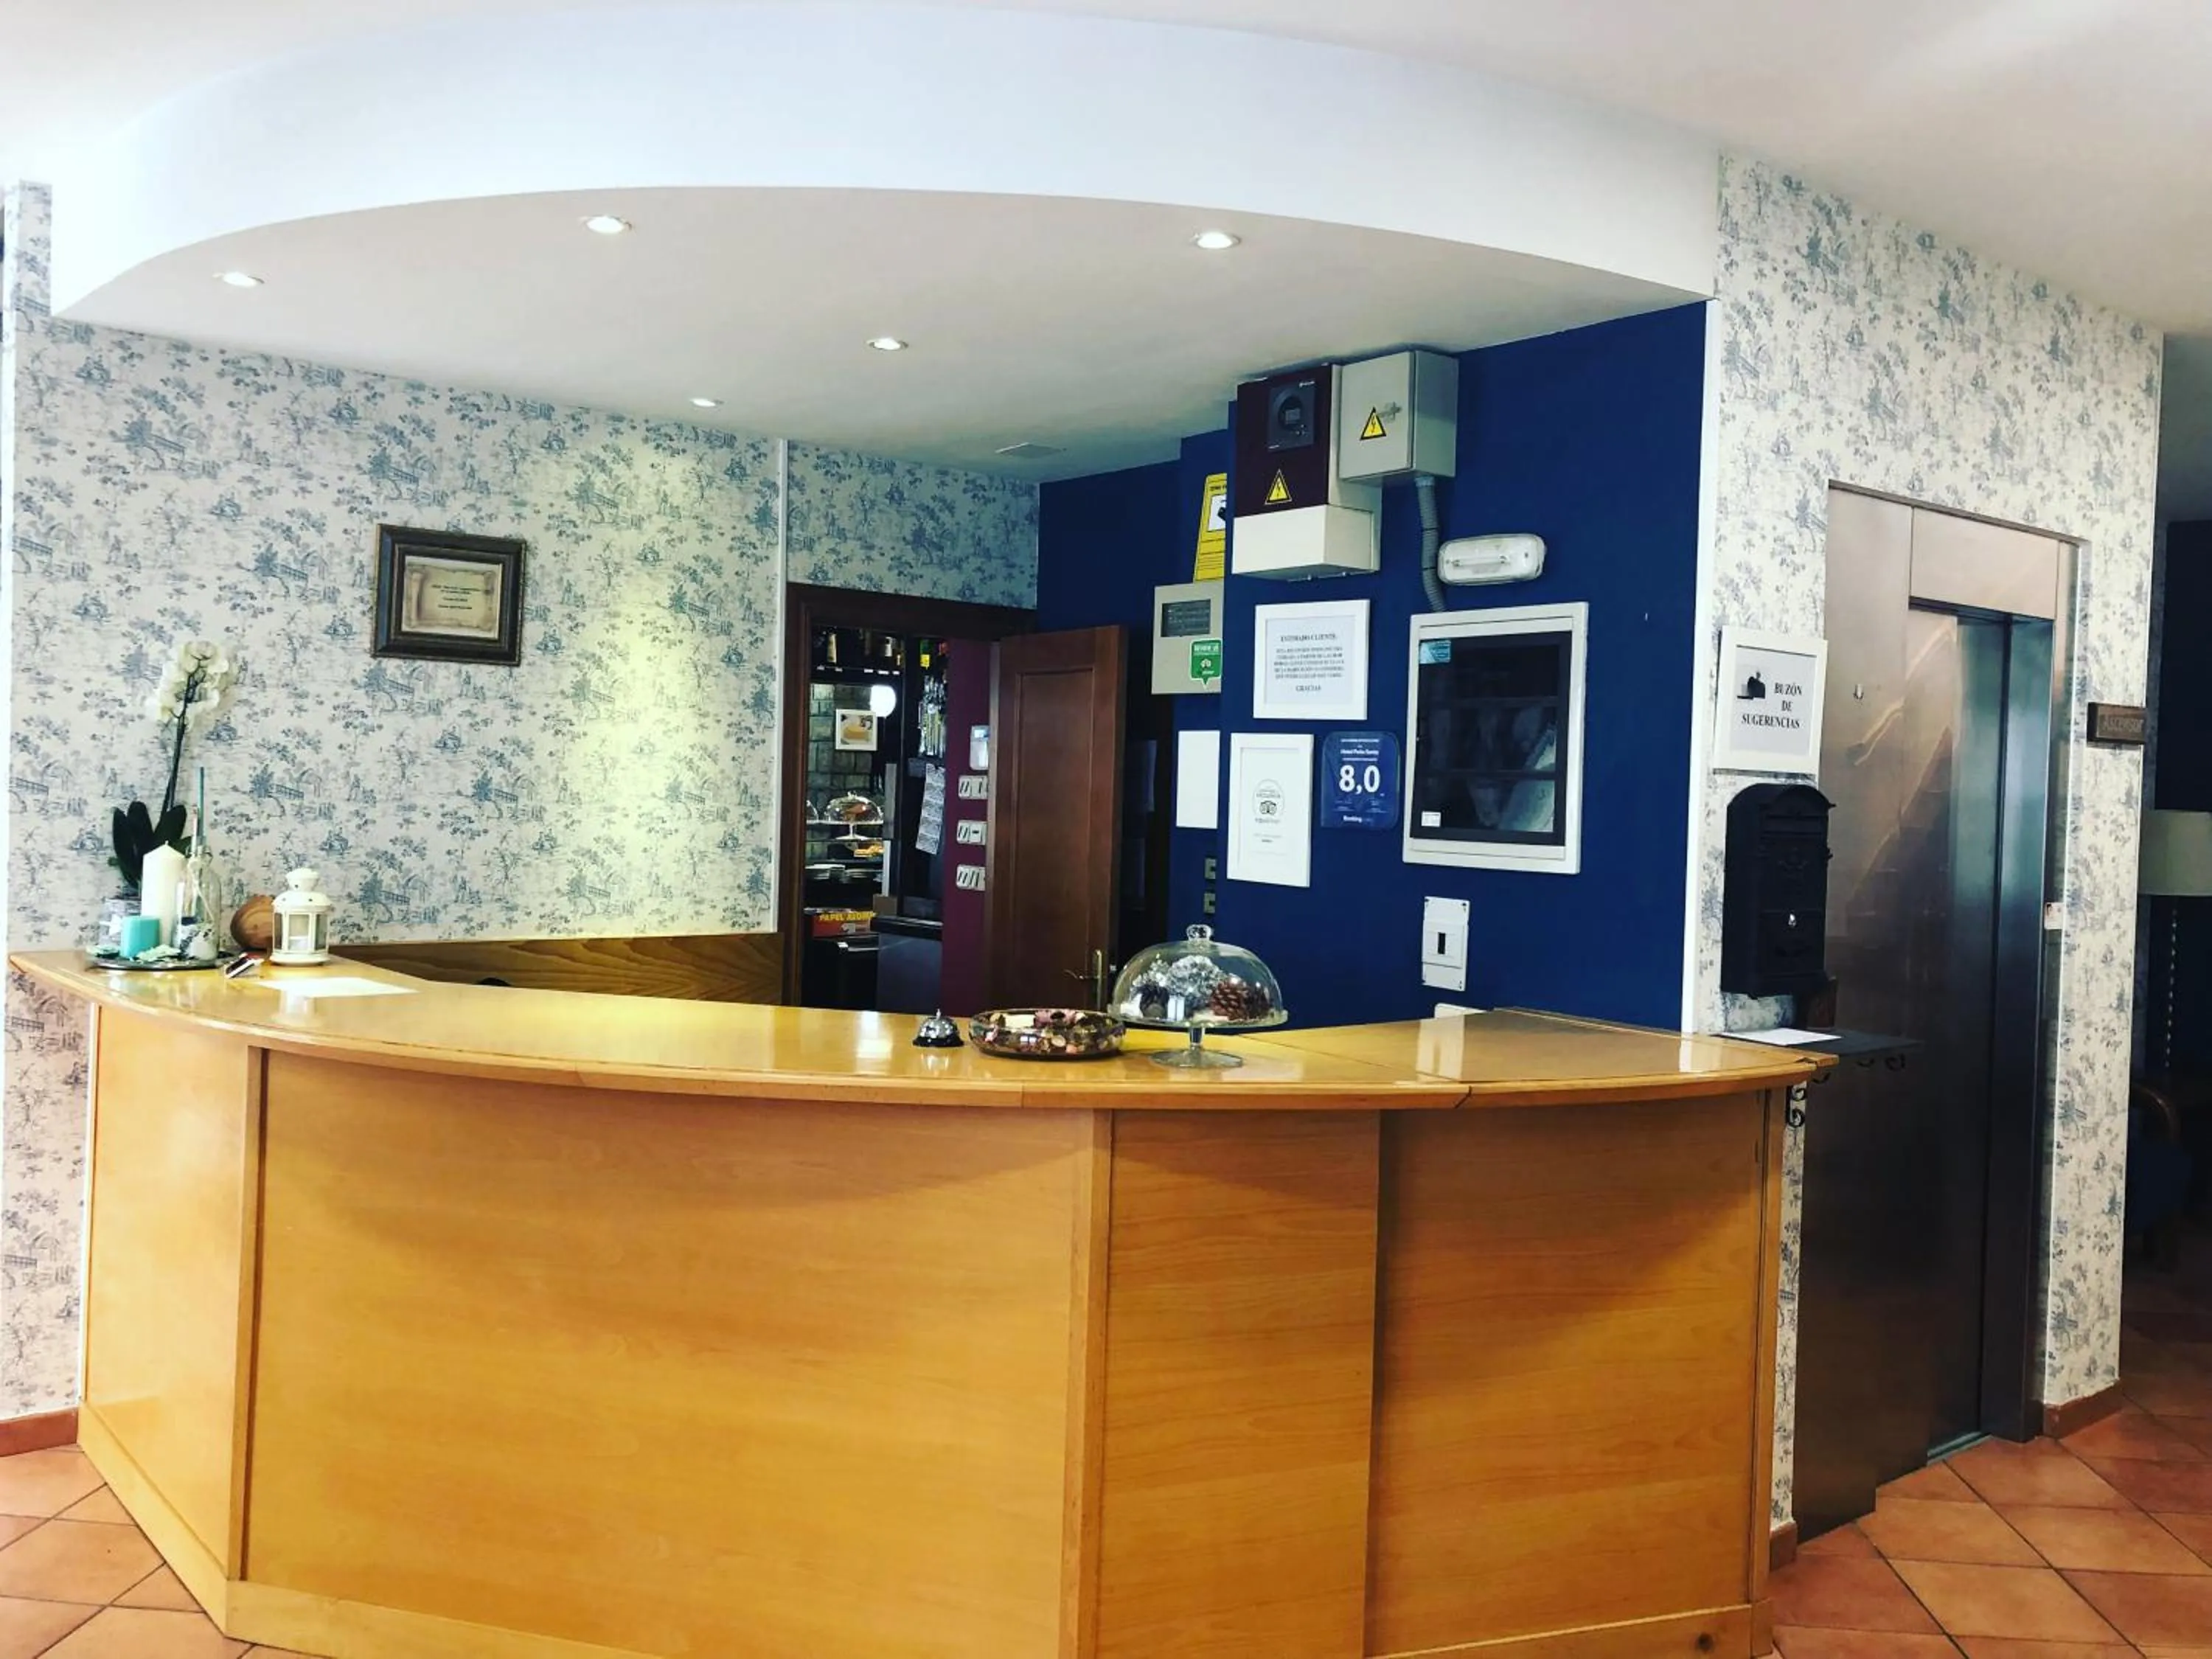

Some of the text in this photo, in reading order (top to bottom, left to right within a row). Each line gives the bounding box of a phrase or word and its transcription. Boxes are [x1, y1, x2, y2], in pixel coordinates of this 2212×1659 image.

[1774, 682, 1802, 696] BUZÓN
[1781, 700, 1793, 712] DE
[1742, 713, 1801, 729] SUGERENCIAS
[1339, 765, 1380, 794] 8,0
